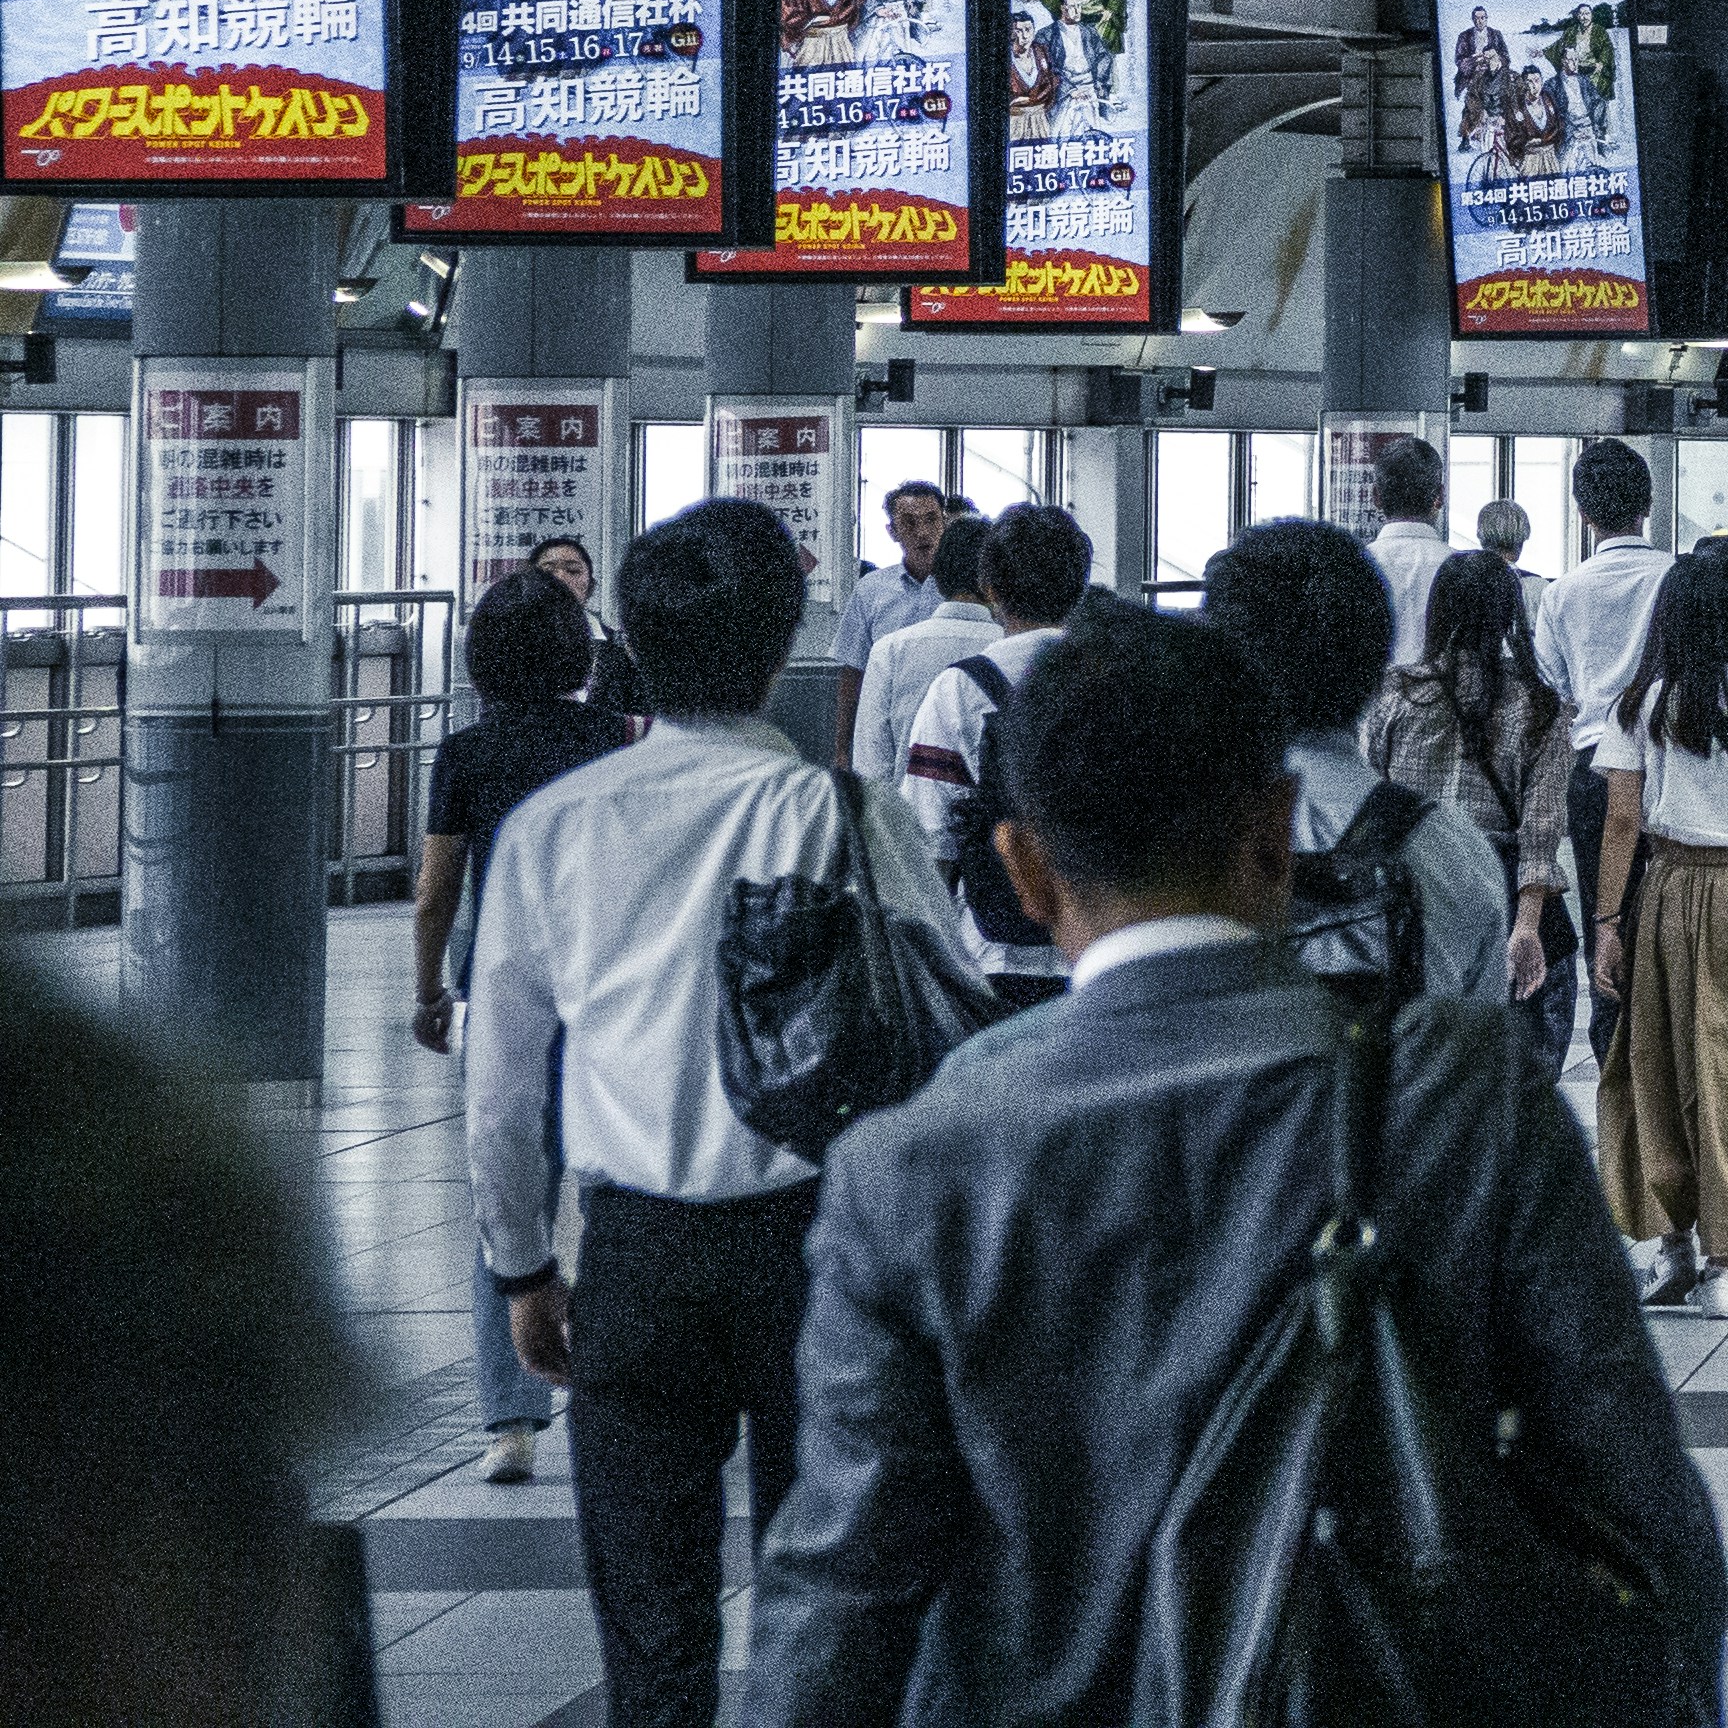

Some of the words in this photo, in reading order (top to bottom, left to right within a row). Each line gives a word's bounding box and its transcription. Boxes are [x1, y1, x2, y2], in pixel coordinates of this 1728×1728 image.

[458, 10, 498, 37] 4回
[475, 67, 702, 133] 高知競輪
[779, 61, 952, 103] 共同通信社杯
[20, 85, 370, 137] パワースポットケイリン
[458, 152, 709, 198] ワースポットケイリン
[1008, 137, 1135, 173] 同通信社杯
[1460, 188, 1507, 206] 第34回
[1509, 171, 1630, 205] 共同通信社杯
[777, 203, 958, 241] スポットケイリン
[1008, 196, 1134, 247] 知競輪
[1496, 222, 1631, 268] 高知競輪
